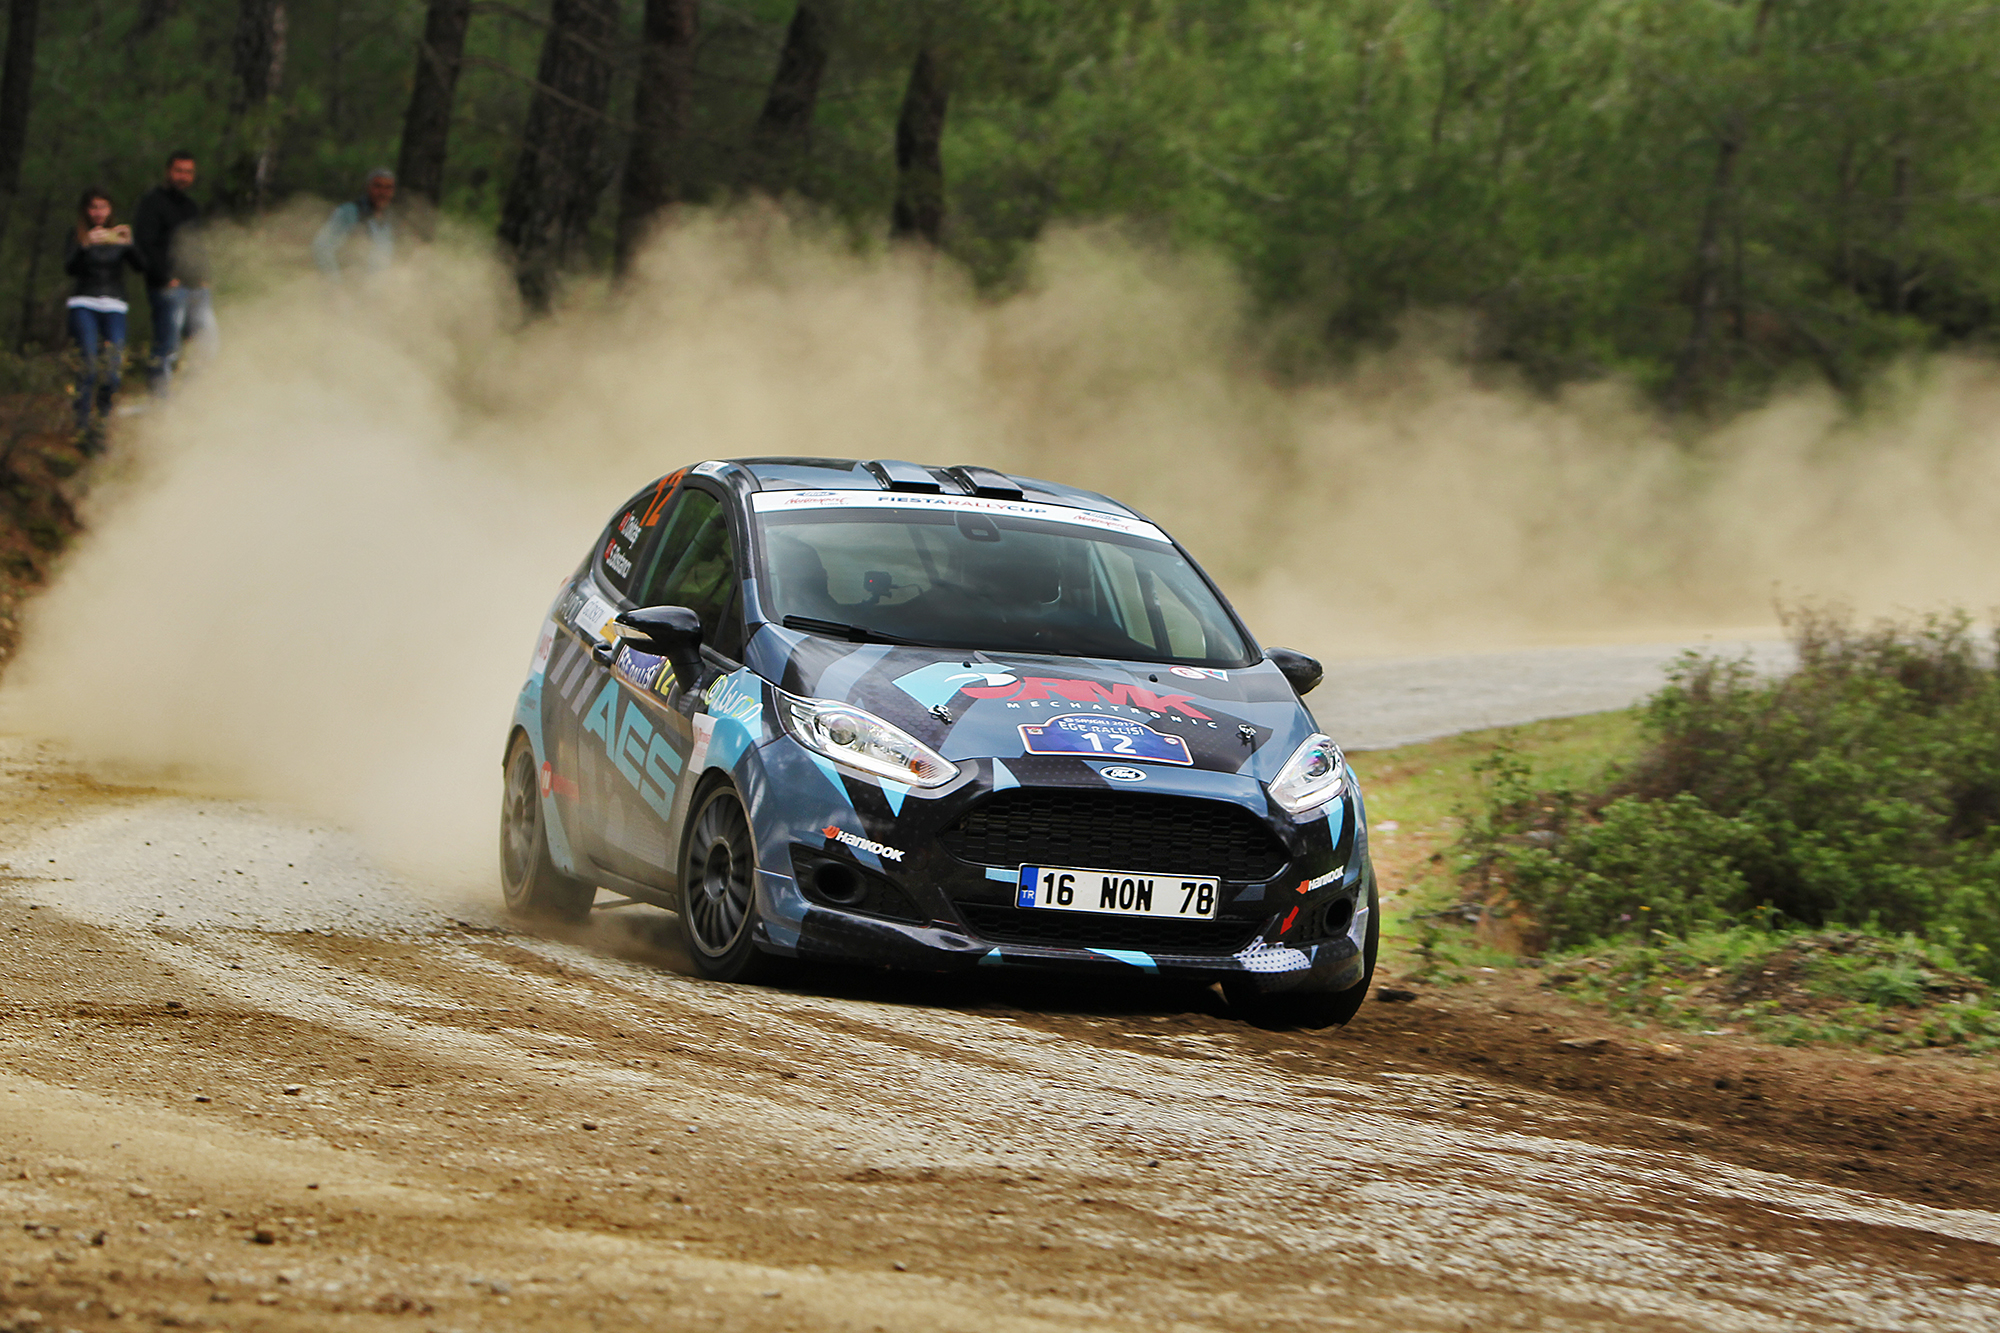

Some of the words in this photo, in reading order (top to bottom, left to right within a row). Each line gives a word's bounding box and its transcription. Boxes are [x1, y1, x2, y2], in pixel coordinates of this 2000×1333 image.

[1006, 701, 1218, 730] MECHATRONIC
[1058, 721, 1088, 732] EGE
[582, 677, 683, 822] AES
[1081, 732, 1137, 754] 12
[1021, 889, 1035, 900] TR
[1043, 872, 1075, 906] 16
[1100, 876, 1154, 912] NON
[1180, 881, 1214, 915] 78
